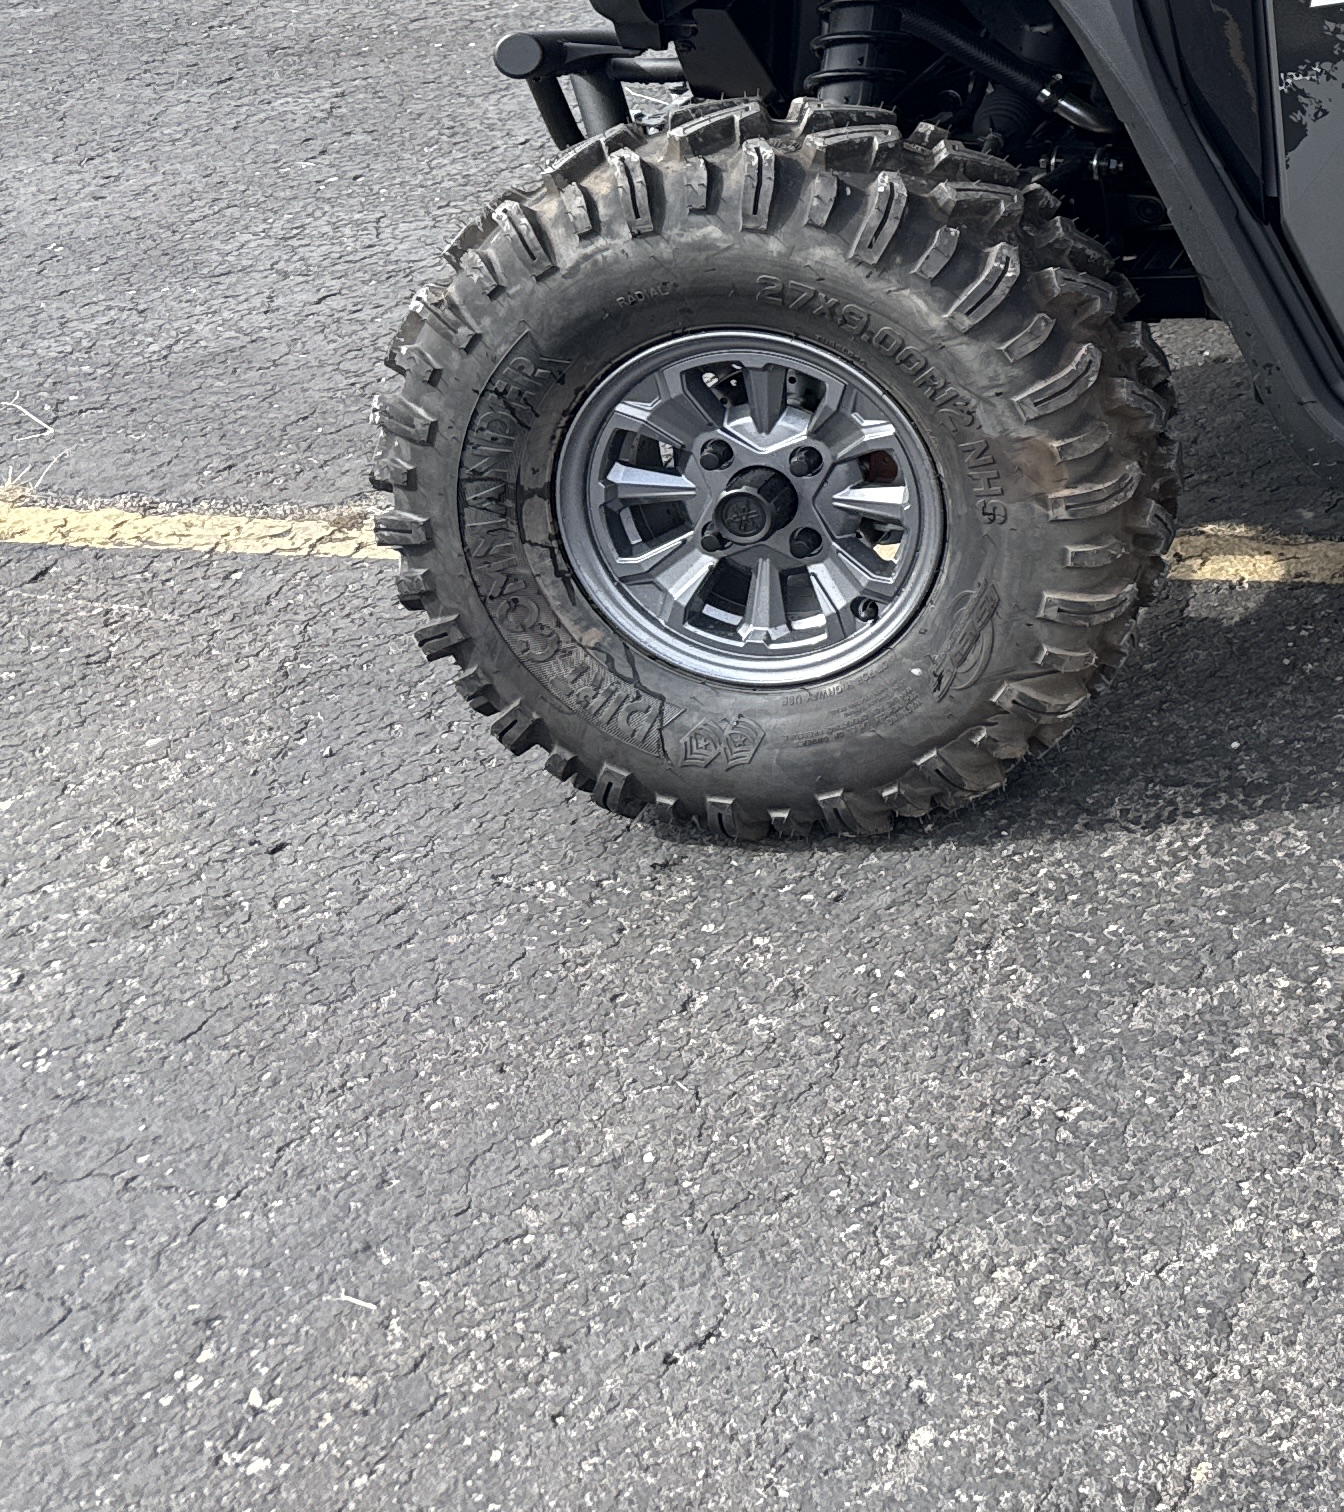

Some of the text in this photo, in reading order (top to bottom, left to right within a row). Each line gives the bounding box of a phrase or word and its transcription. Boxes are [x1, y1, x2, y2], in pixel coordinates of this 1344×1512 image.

[616, 286, 670, 308] RADIAL
[958, 439, 1008, 525] NHS
[465, 356, 660, 742] DIRT COMMANDER
